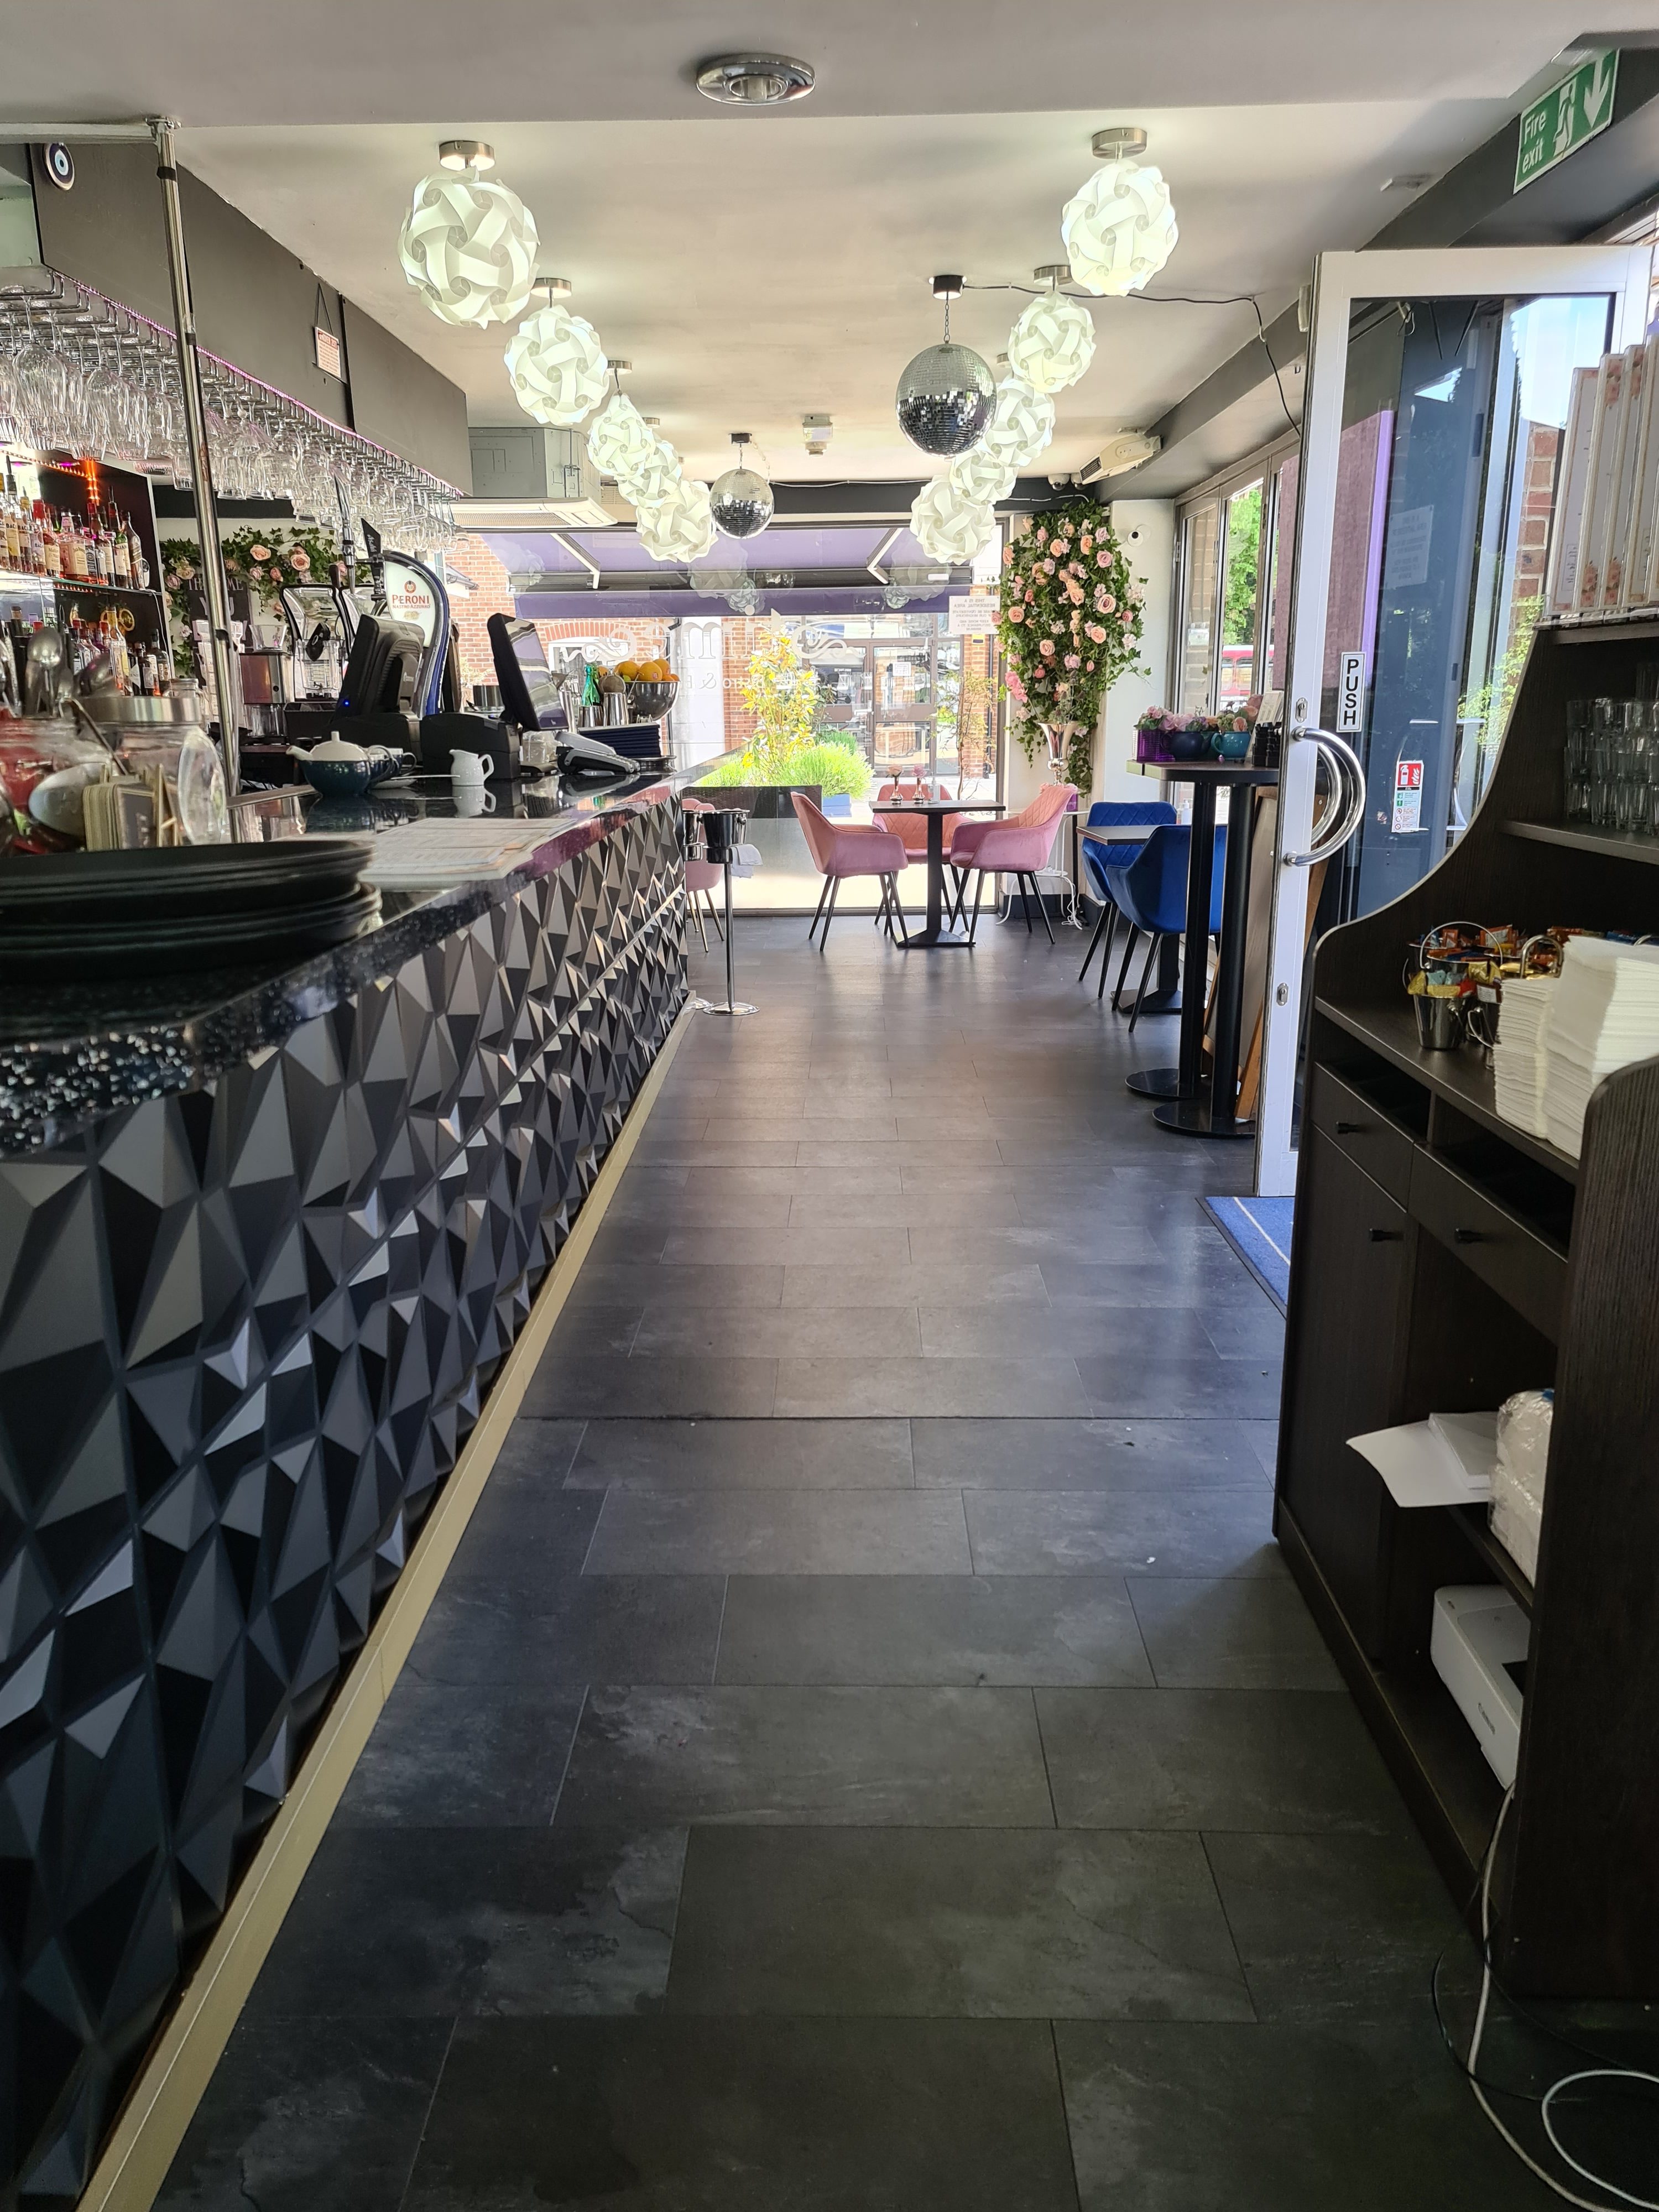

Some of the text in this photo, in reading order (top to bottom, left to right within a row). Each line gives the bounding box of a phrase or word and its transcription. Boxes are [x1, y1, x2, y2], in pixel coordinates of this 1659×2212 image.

[1524, 111, 1546, 145] Fire
[1522, 137, 1544, 174] exit
[392, 594, 430, 604] PERONI
[1343, 659, 1359, 726] PUSH
